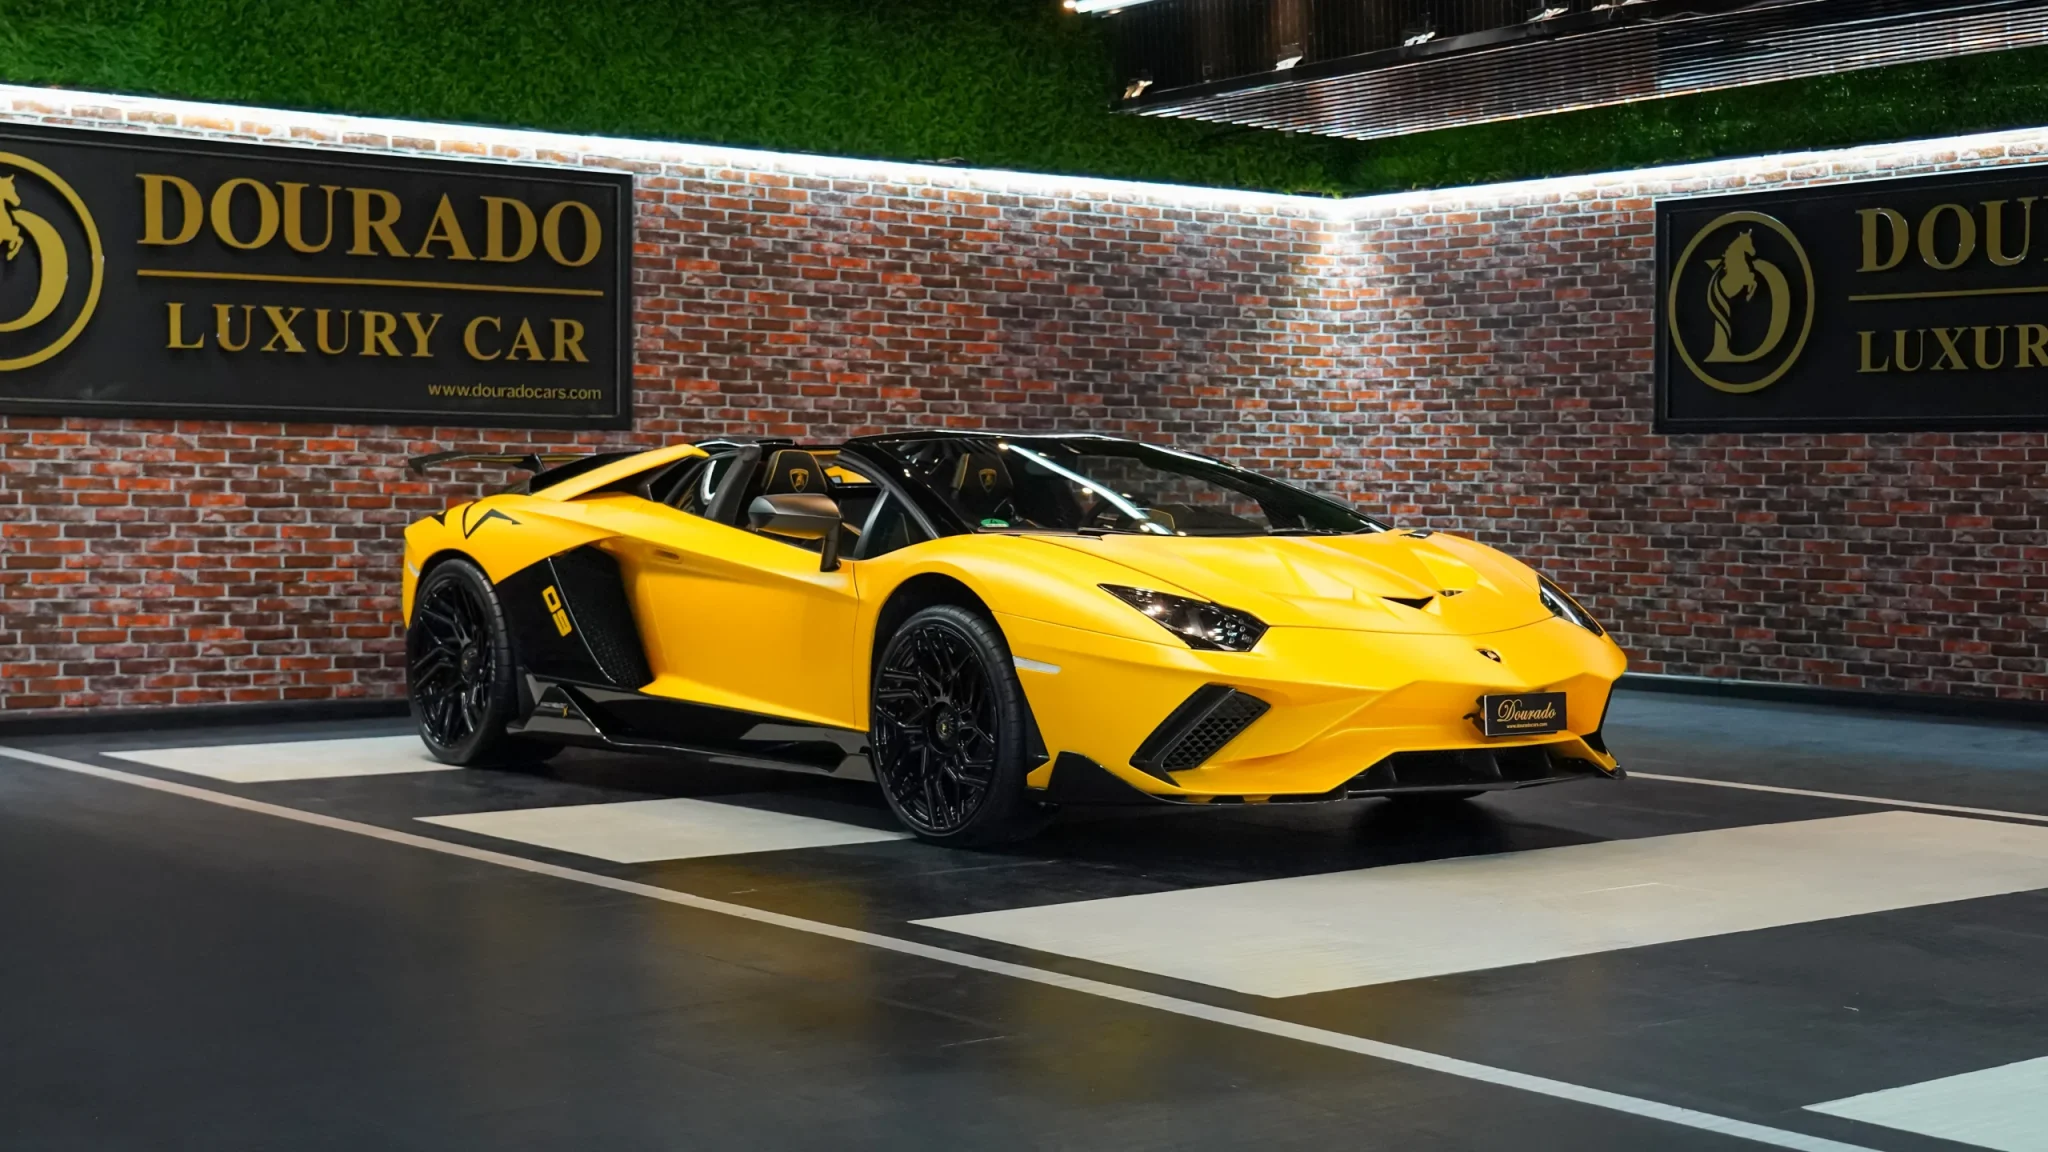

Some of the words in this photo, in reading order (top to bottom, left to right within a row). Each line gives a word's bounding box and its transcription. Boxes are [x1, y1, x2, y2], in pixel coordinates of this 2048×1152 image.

[137, 173, 603, 268] DOURADO
[1856, 196, 2048, 272] DOU
[167, 302, 443, 359] LUXURY
[464, 316, 590, 363] CAR
[428, 383, 602, 400] www.douradocars.com
[1497, 699, 1556, 722] Dourado
